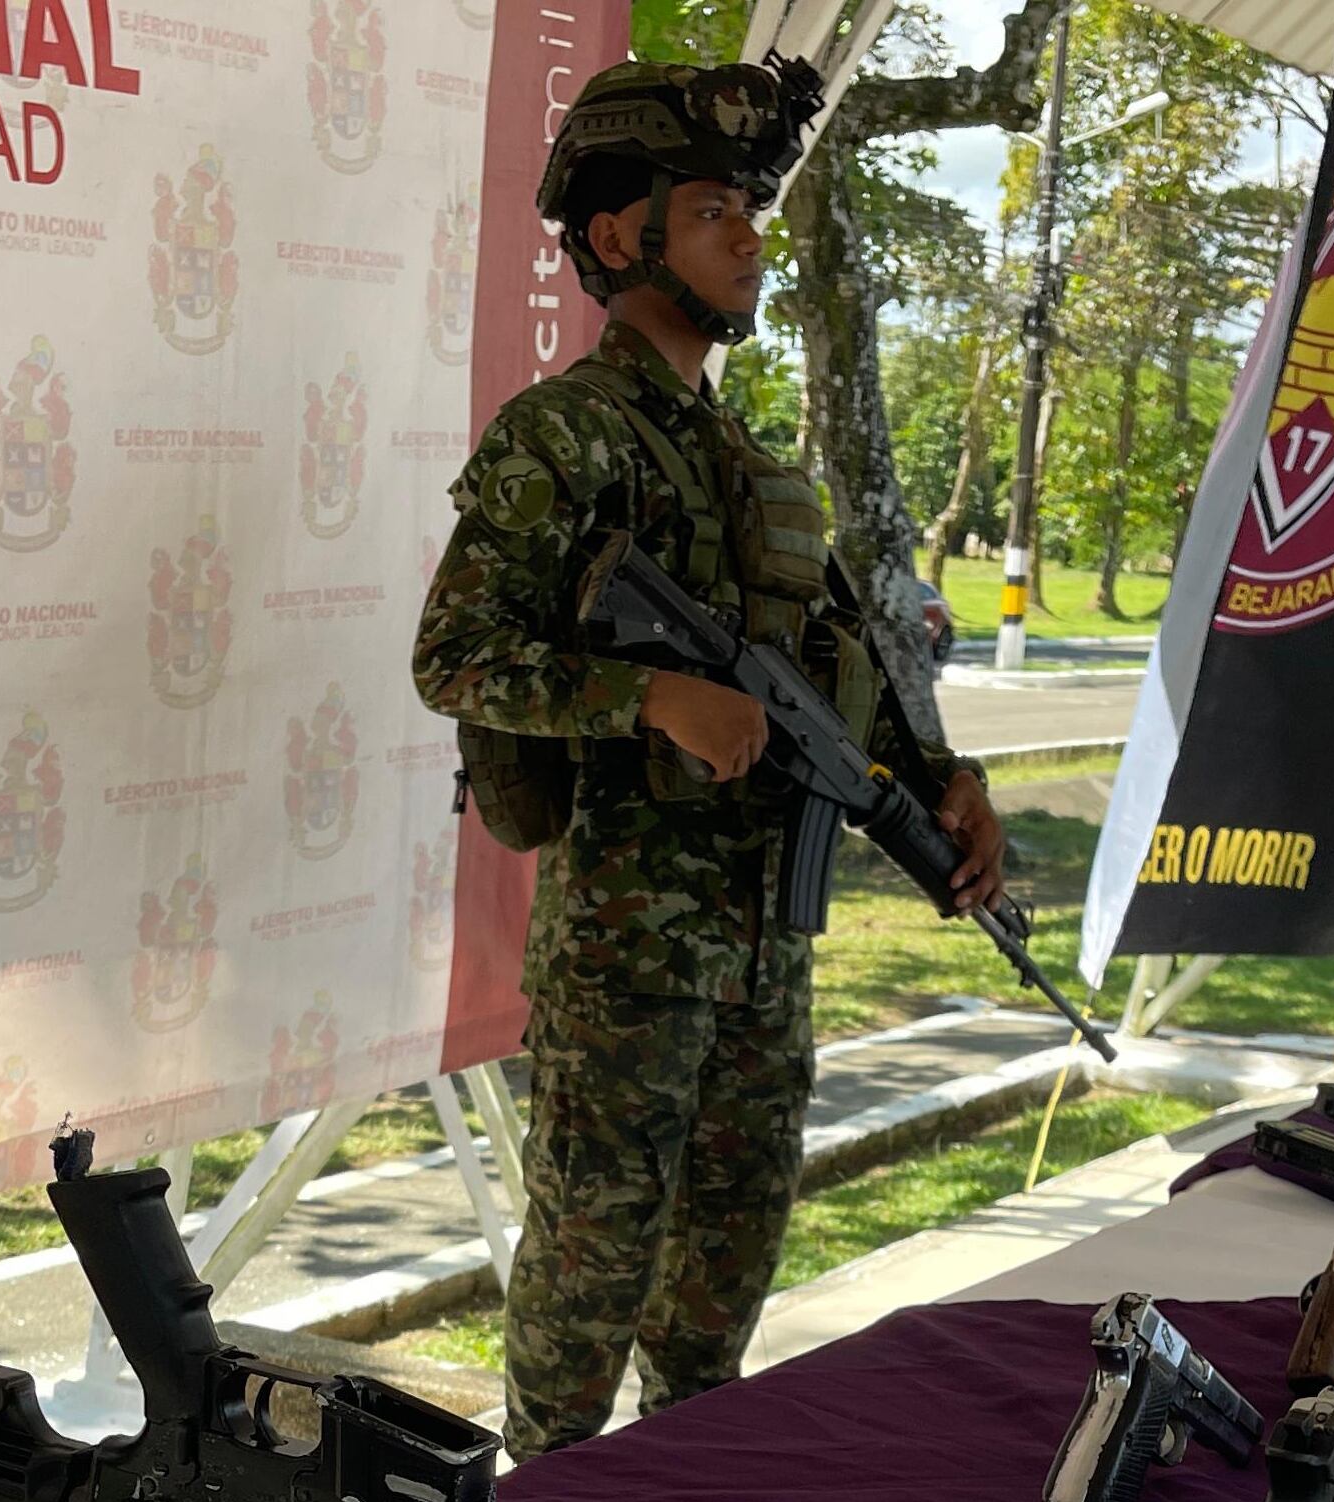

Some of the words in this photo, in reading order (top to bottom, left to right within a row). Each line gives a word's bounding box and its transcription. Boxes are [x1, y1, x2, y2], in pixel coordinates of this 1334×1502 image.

[24, 213, 108, 241] NACIONAL
[1283, 426, 1332, 474] 17
[15, 602, 97, 623] NACIONAL
[1184, 825, 1211, 884] O
[1206, 826, 1315, 890] MORIR
